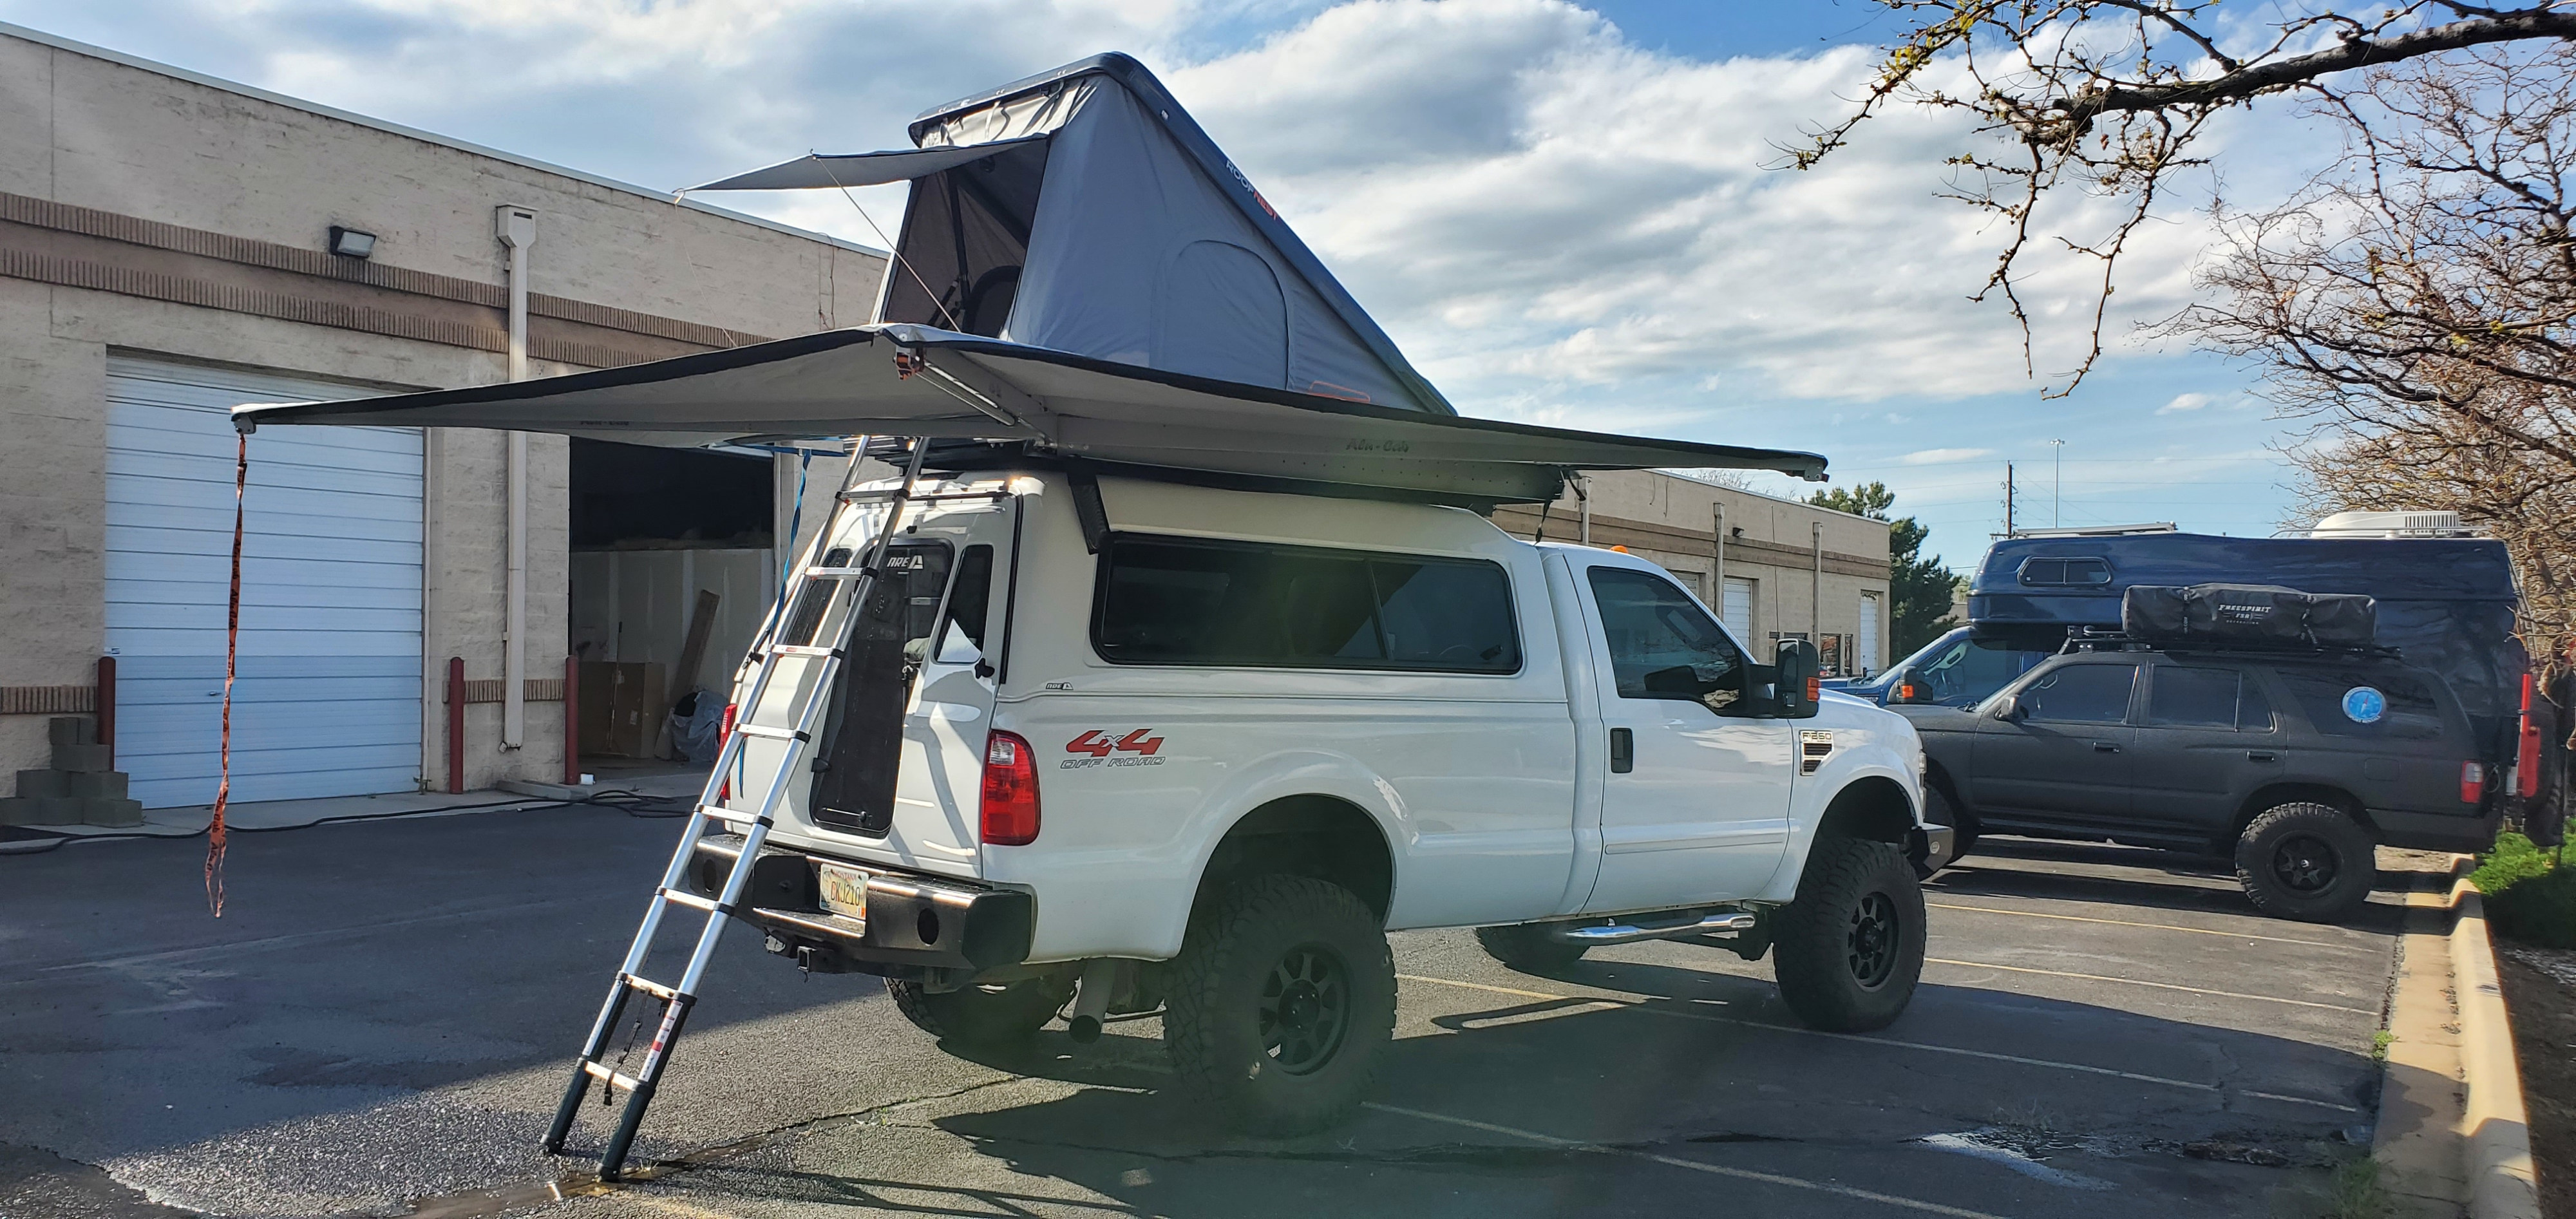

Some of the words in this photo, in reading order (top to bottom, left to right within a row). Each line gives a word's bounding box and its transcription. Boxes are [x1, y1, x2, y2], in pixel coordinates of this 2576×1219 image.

[1226, 160, 1278, 220] ROOFNEST
[2218, 604, 2271, 613] FREESPIRIT
[1066, 728, 1165, 757] 4x4
[1061, 758, 1104, 769] OFF
[1108, 756, 1166, 767] ROAD
[831, 881, 860, 907] CKJ210
